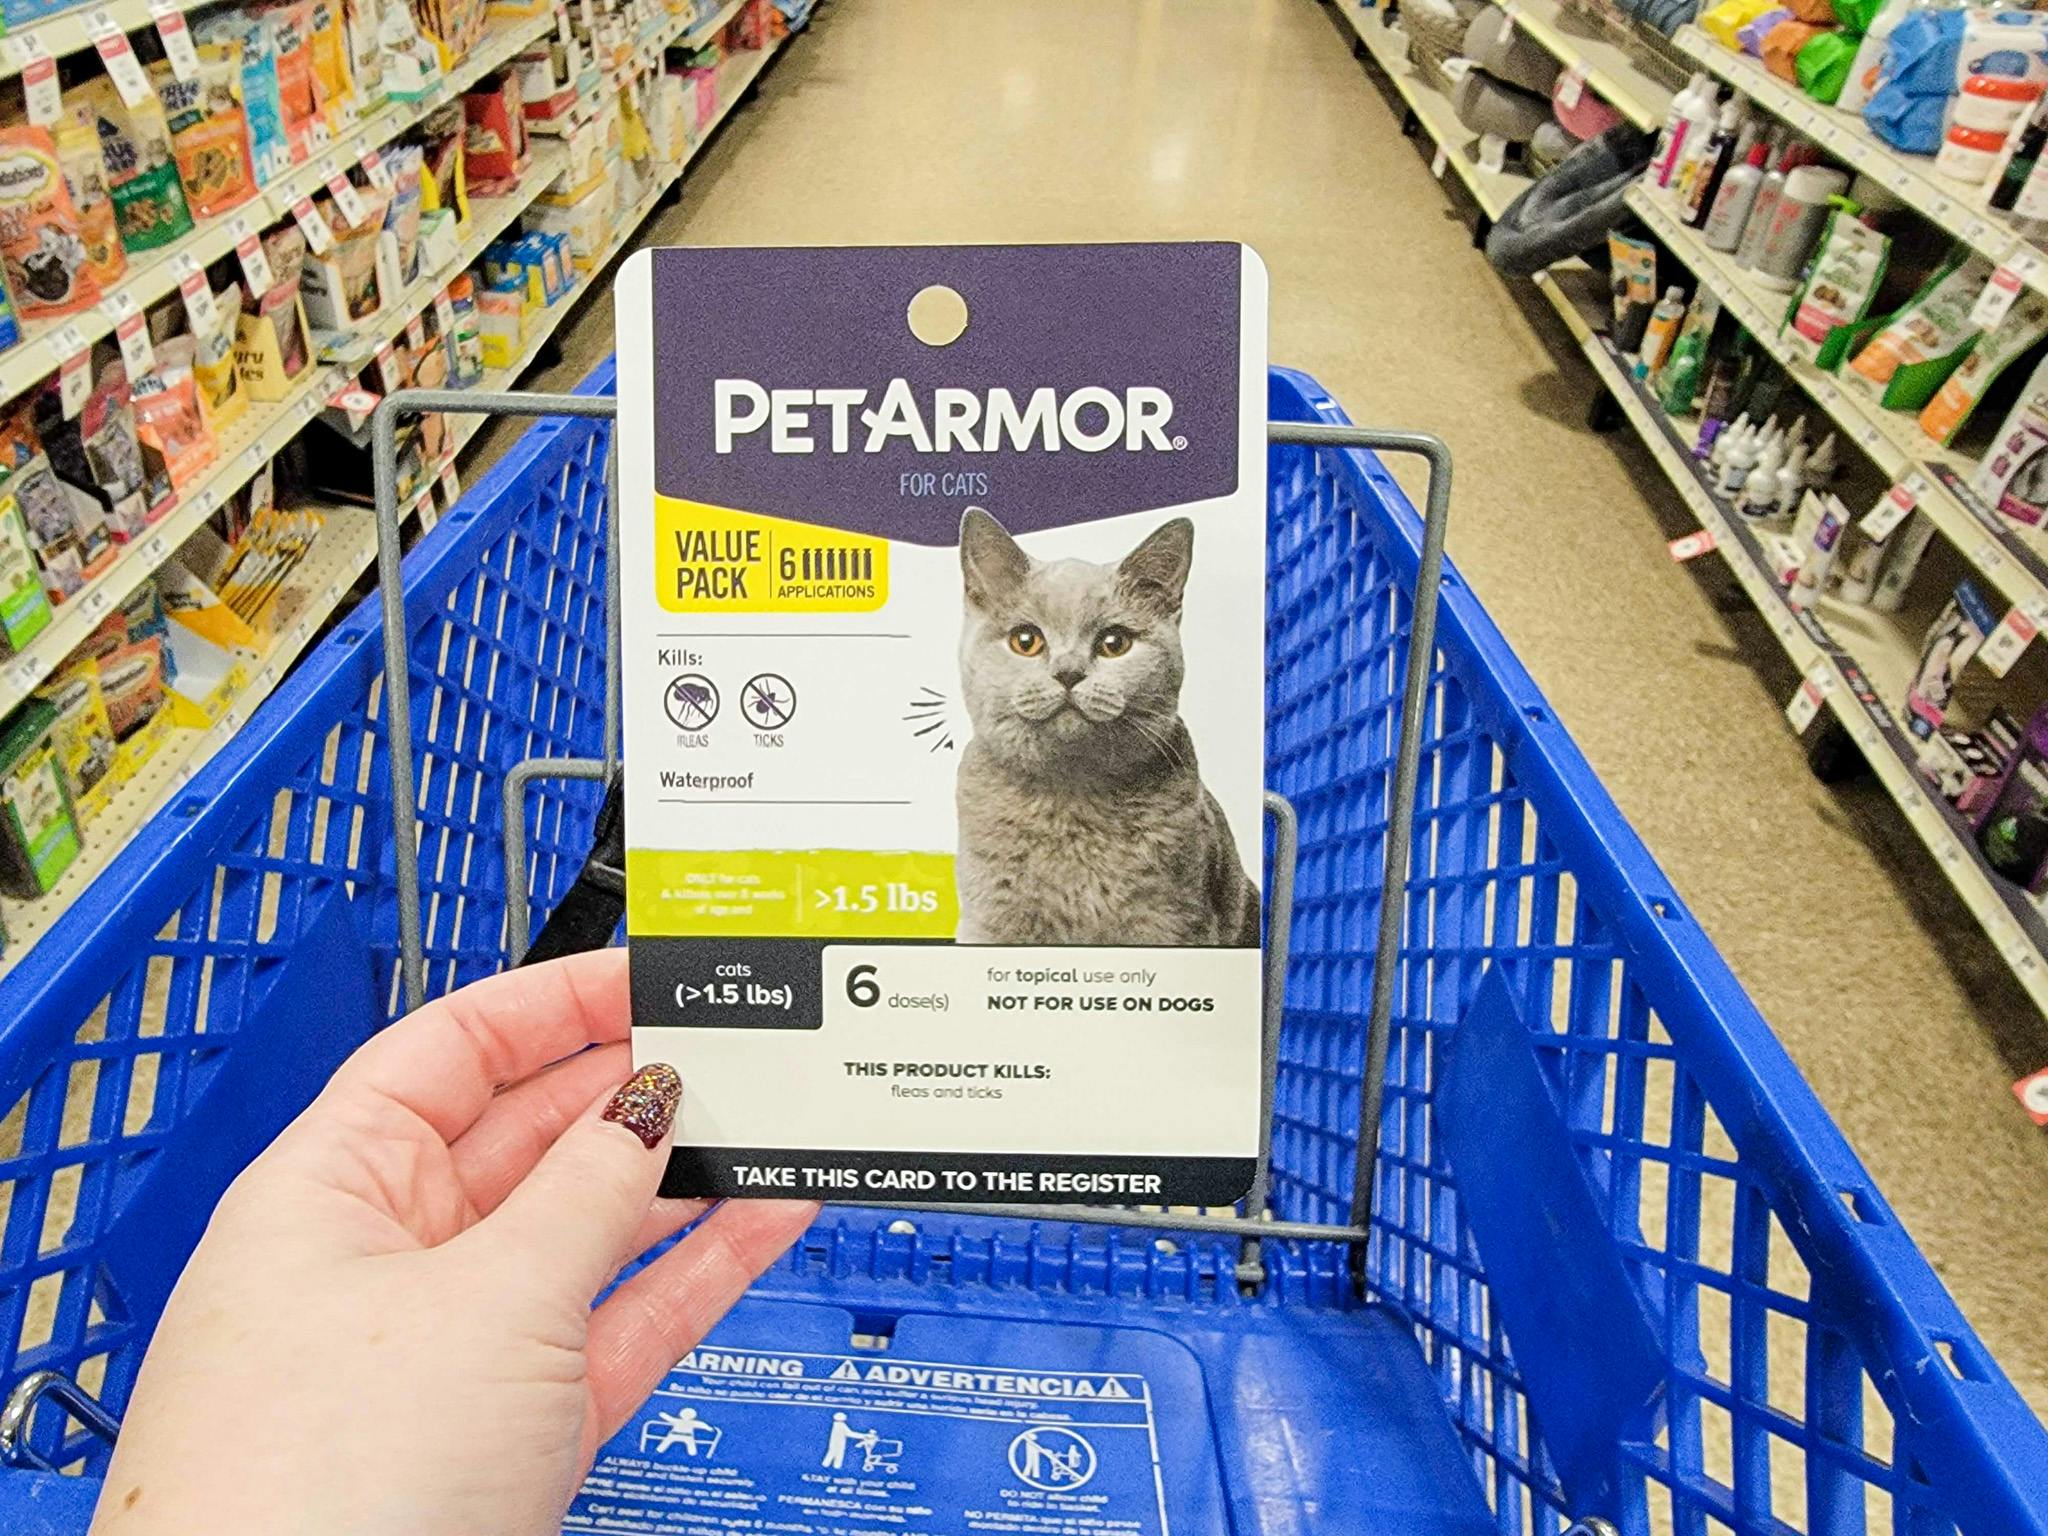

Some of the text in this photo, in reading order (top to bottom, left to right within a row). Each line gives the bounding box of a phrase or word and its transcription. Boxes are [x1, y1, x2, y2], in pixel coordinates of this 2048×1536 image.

[900, 473, 988, 496] FOR CATS
[675, 530, 762, 562] VALUE
[779, 547, 796, 581] 6
[676, 567, 748, 599] PACK
[777, 585, 876, 599] APPLICATIONS
[657, 649, 703, 666] Kills:
[753, 733, 785, 747] TICKS
[659, 771, 755, 791] Waterproof
[814, 882, 939, 914] >1.5 lbs
[715, 963, 752, 977] cats
[987, 967, 1157, 987] for topical use only
[675, 983, 793, 1010] (>1.5 lbs)
[845, 964, 950, 1012] 6 dose(s)
[986, 996, 1215, 1012] NOT FOR USE ON DOGS
[843, 1062, 1052, 1079] THIS PRODUCT KILLS:
[891, 1084, 1003, 1099] fleas and ticks
[732, 1166, 1161, 1193] TAKE THIS CARD TO THE REGISTER
[675, 1351, 804, 1377] ARNING
[865, 1365, 1097, 1398] ADVERTENCIA
